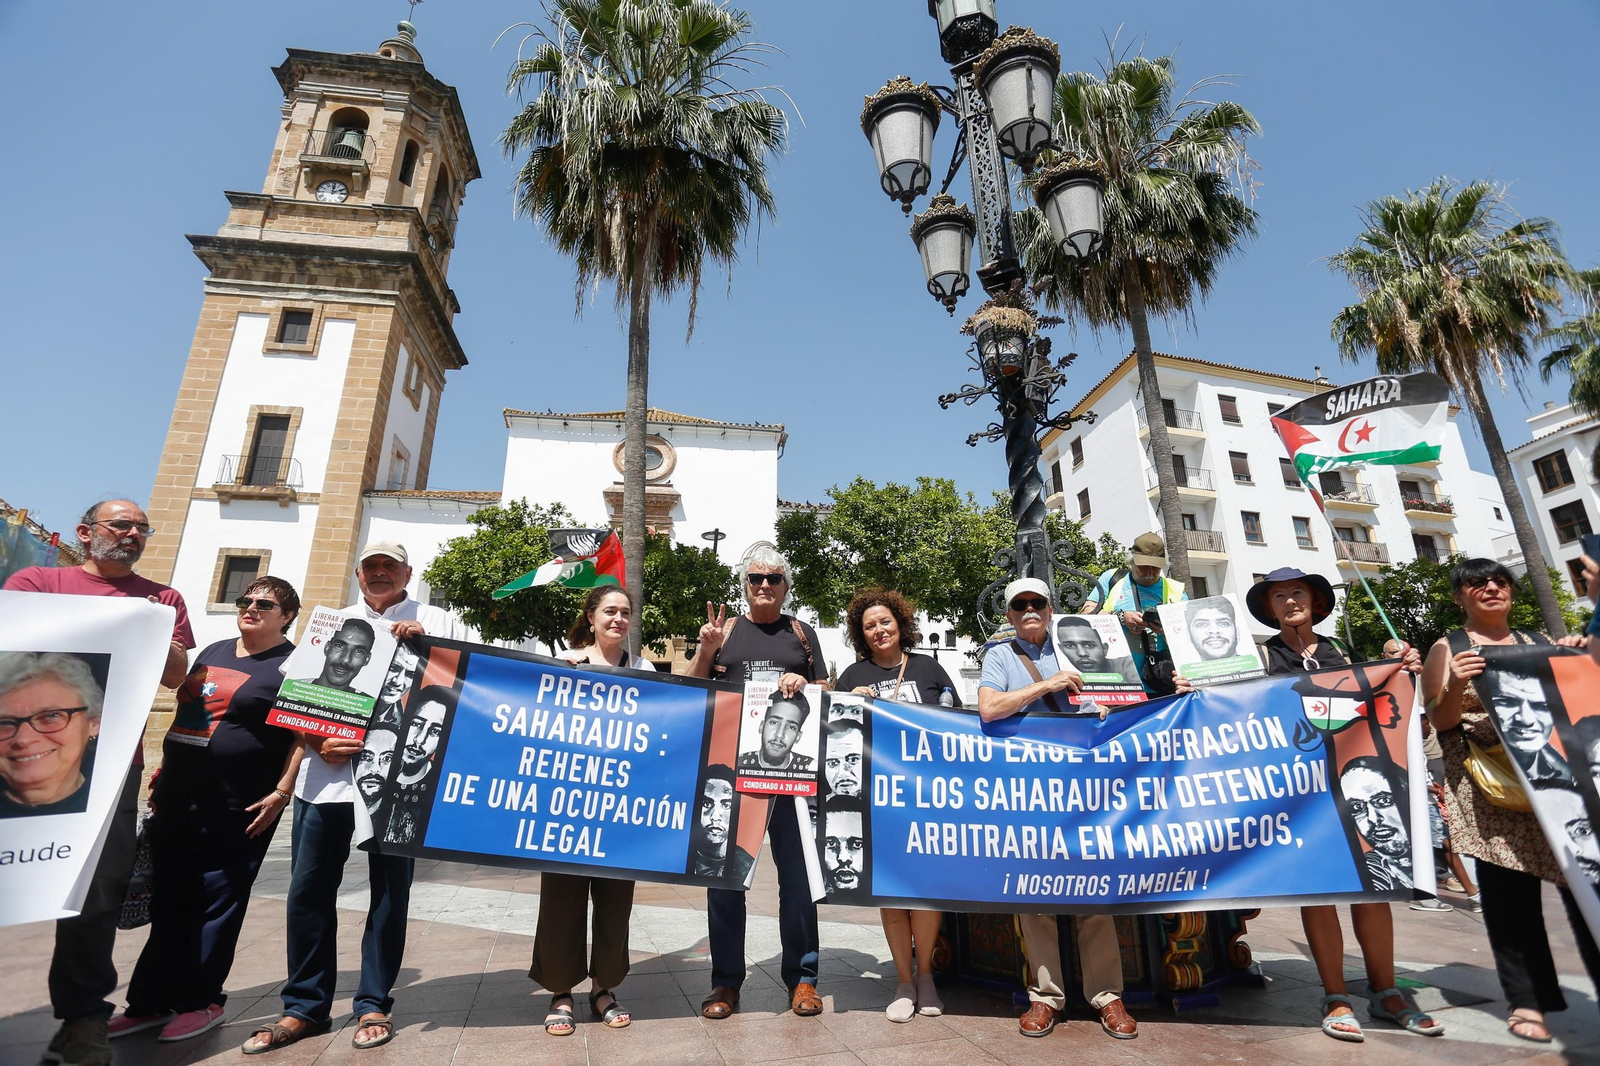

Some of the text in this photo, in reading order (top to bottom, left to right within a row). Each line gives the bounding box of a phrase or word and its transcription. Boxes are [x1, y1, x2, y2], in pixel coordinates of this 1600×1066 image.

[1325, 379, 1402, 420] SAHARA
[312, 620, 341, 630] MOHAMED
[314, 612, 339, 622] LIBERAR
[292, 682, 317, 691] PRESIDENTE
[536, 674, 640, 715] PRESOS
[276, 714, 356, 738] CONDENADO A 20 AÑOS
[283, 702, 308, 712] DETENCIÓN
[308, 708, 333, 718] ARBITRARIA
[340, 714, 367, 726] MARRUECOS
[492, 704, 650, 753] SAHARAUIS
[901, 730, 933, 761] LA
[942, 732, 992, 762] ONU
[1092, 740, 1126, 762] LA
[1130, 712, 1288, 762] LIBERACIÓN
[518, 747, 631, 788] REHENES
[765, 770, 786, 778] ARBITRARIA
[874, 754, 1327, 812] DE LOS SAHARAUIS EN DETENCIÓN
[443, 773, 687, 830] DE UNA OCUPACIÓN
[743, 780, 778, 790] CONDENADO
[794, 782, 810, 792] AÑOS
[515, 818, 606, 858] ILEGAL
[906, 812, 1304, 860] ARBITRARIA EN MARRUECOS,
[0, 842, 71, 866] aude
[1016, 874, 1110, 896] NOSOTROS
[1118, 869, 1198, 896] TAMBIÉN
[1202, 869, 1210, 890] !
